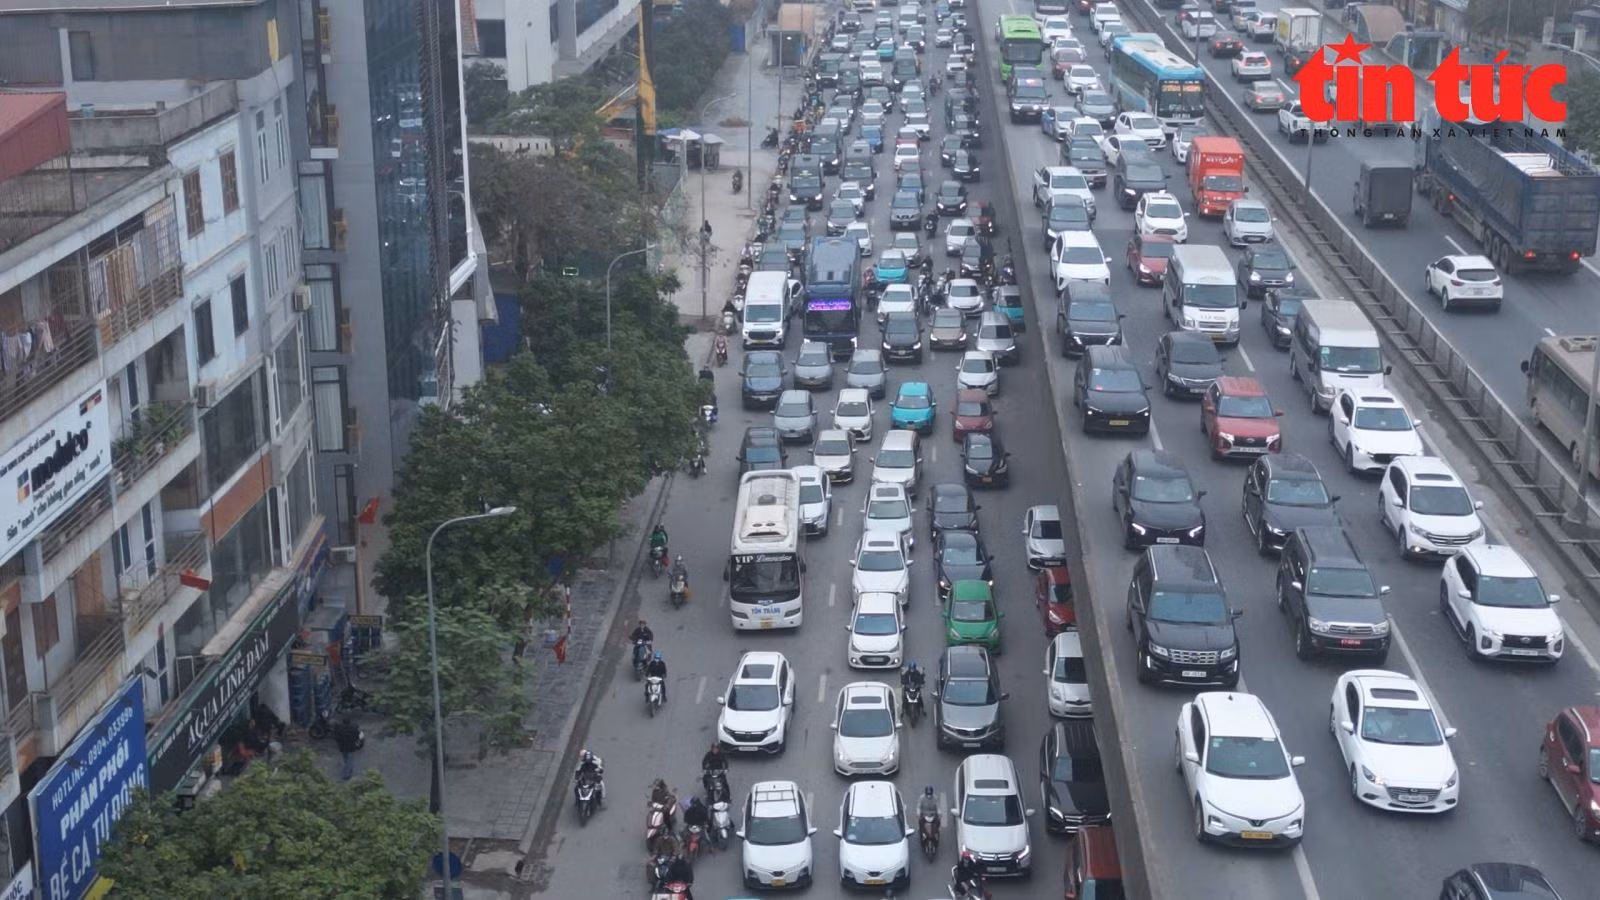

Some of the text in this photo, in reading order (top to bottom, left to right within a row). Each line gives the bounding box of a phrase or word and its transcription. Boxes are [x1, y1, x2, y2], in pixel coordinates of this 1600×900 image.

[735, 555, 754, 564] VIP
[60, 737, 129, 842] PHÂN PHỐI
[71, 830, 91, 885] CÁ
